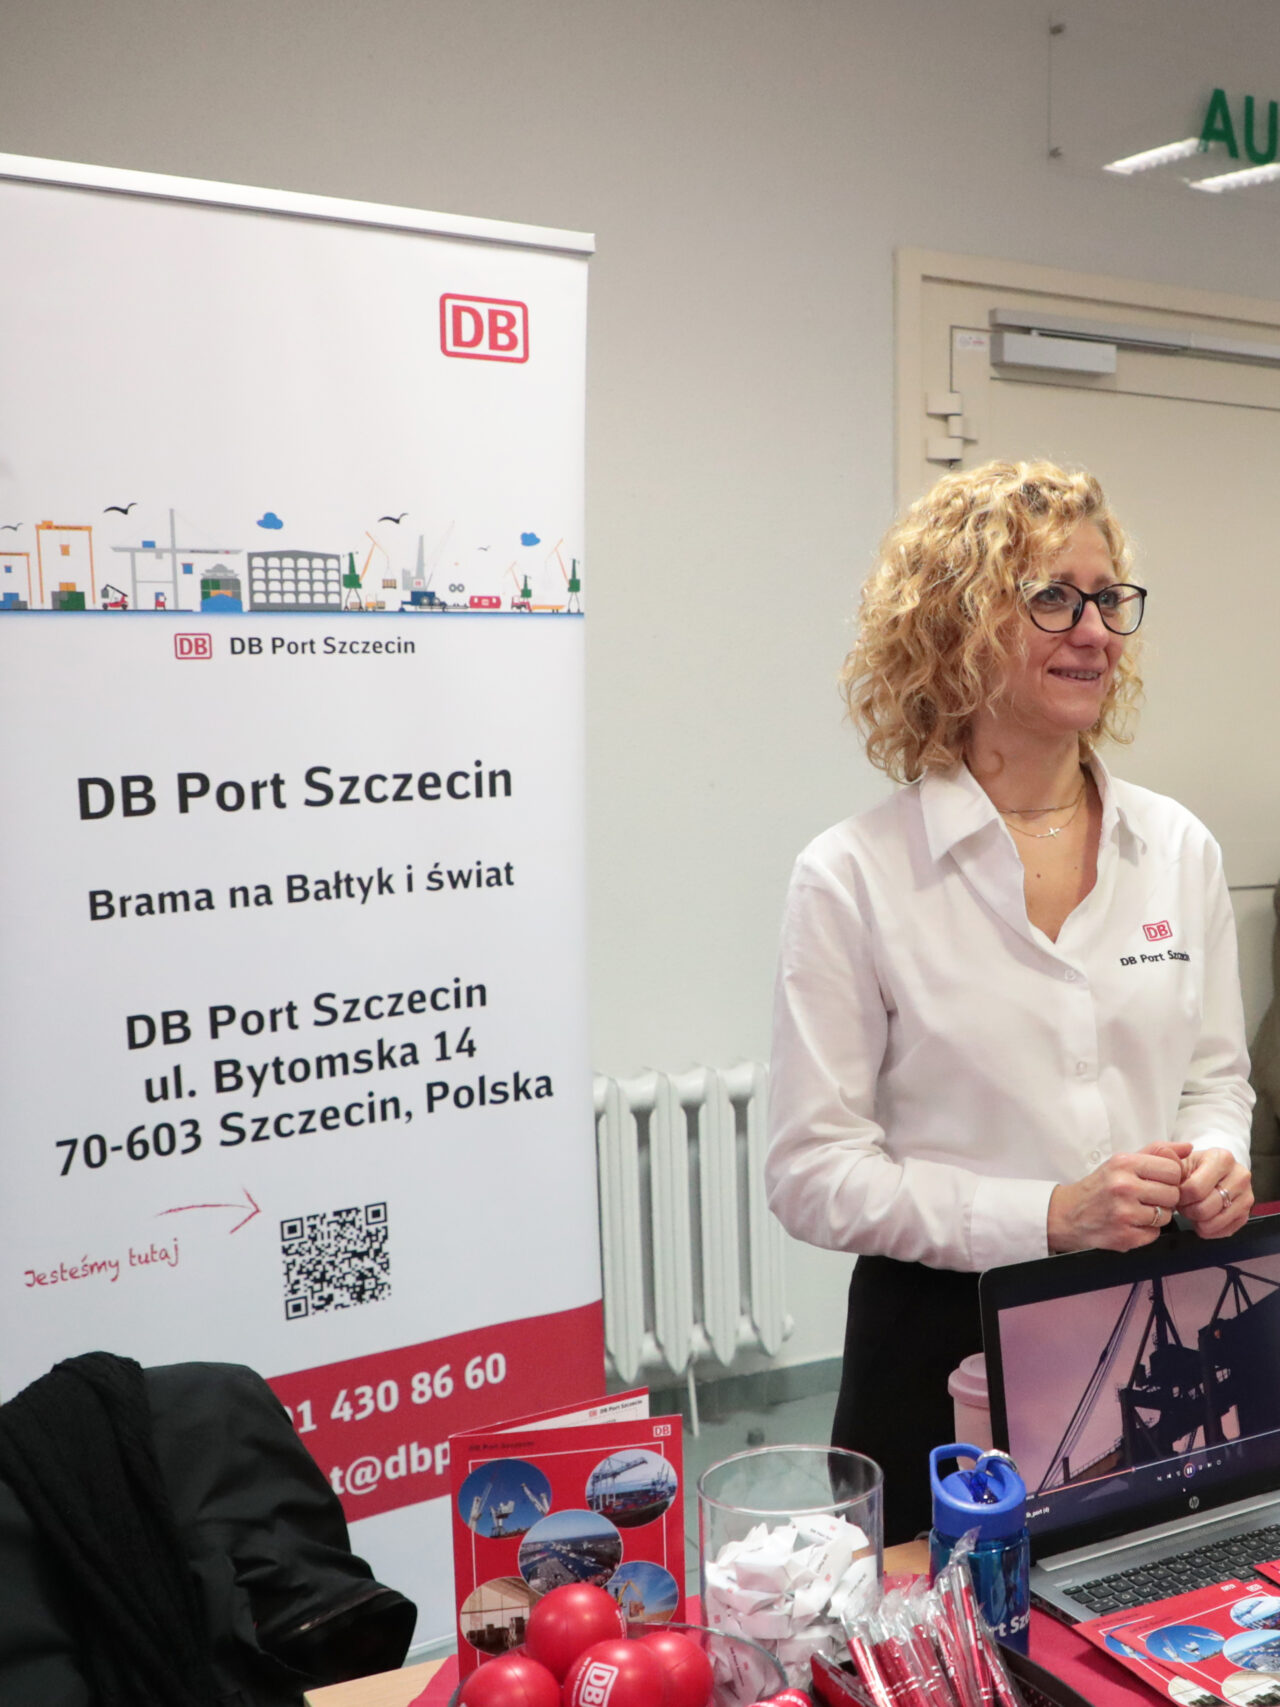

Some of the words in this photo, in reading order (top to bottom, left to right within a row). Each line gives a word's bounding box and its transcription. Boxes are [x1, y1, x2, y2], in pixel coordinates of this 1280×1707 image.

[450, 303, 521, 354] DB
[178, 636, 209, 656] DB
[229, 635, 263, 655] DB
[270, 635, 316, 656] Port
[322, 634, 416, 655] Szczecin
[77, 774, 157, 820] DB
[176, 770, 287, 814] Port
[303, 760, 513, 808] Szczecin
[88, 886, 215, 921] Brama
[228, 882, 273, 909] na
[286, 867, 395, 904] Bałtyk
[405, 864, 415, 893] i
[426, 861, 515, 891] świat
[1146, 924, 1169, 939] DB
[1119, 956, 1138, 966] DB
[1140, 953, 1165, 963] Port
[125, 1009, 192, 1050] DB
[208, 1000, 299, 1040] Port
[312, 977, 488, 1027] Szczecin
[144, 1065, 198, 1103] ul.
[213, 1037, 420, 1099] Bytomska
[433, 1027, 478, 1062] 14
[55, 1119, 202, 1176] 70-603
[219, 1092, 415, 1149] Szczecin,
[425, 1071, 554, 1114] Polska
[23, 1255, 121, 1288] Jesteśmy
[128, 1237, 180, 1268] tutaj
[283, 1400, 317, 1434] 1
[330, 1380, 400, 1423] 430
[410, 1364, 454, 1405] 86
[464, 1353, 507, 1391] 60
[654, 1425, 671, 1437] DB
[583, 1667, 613, 1705] DB
